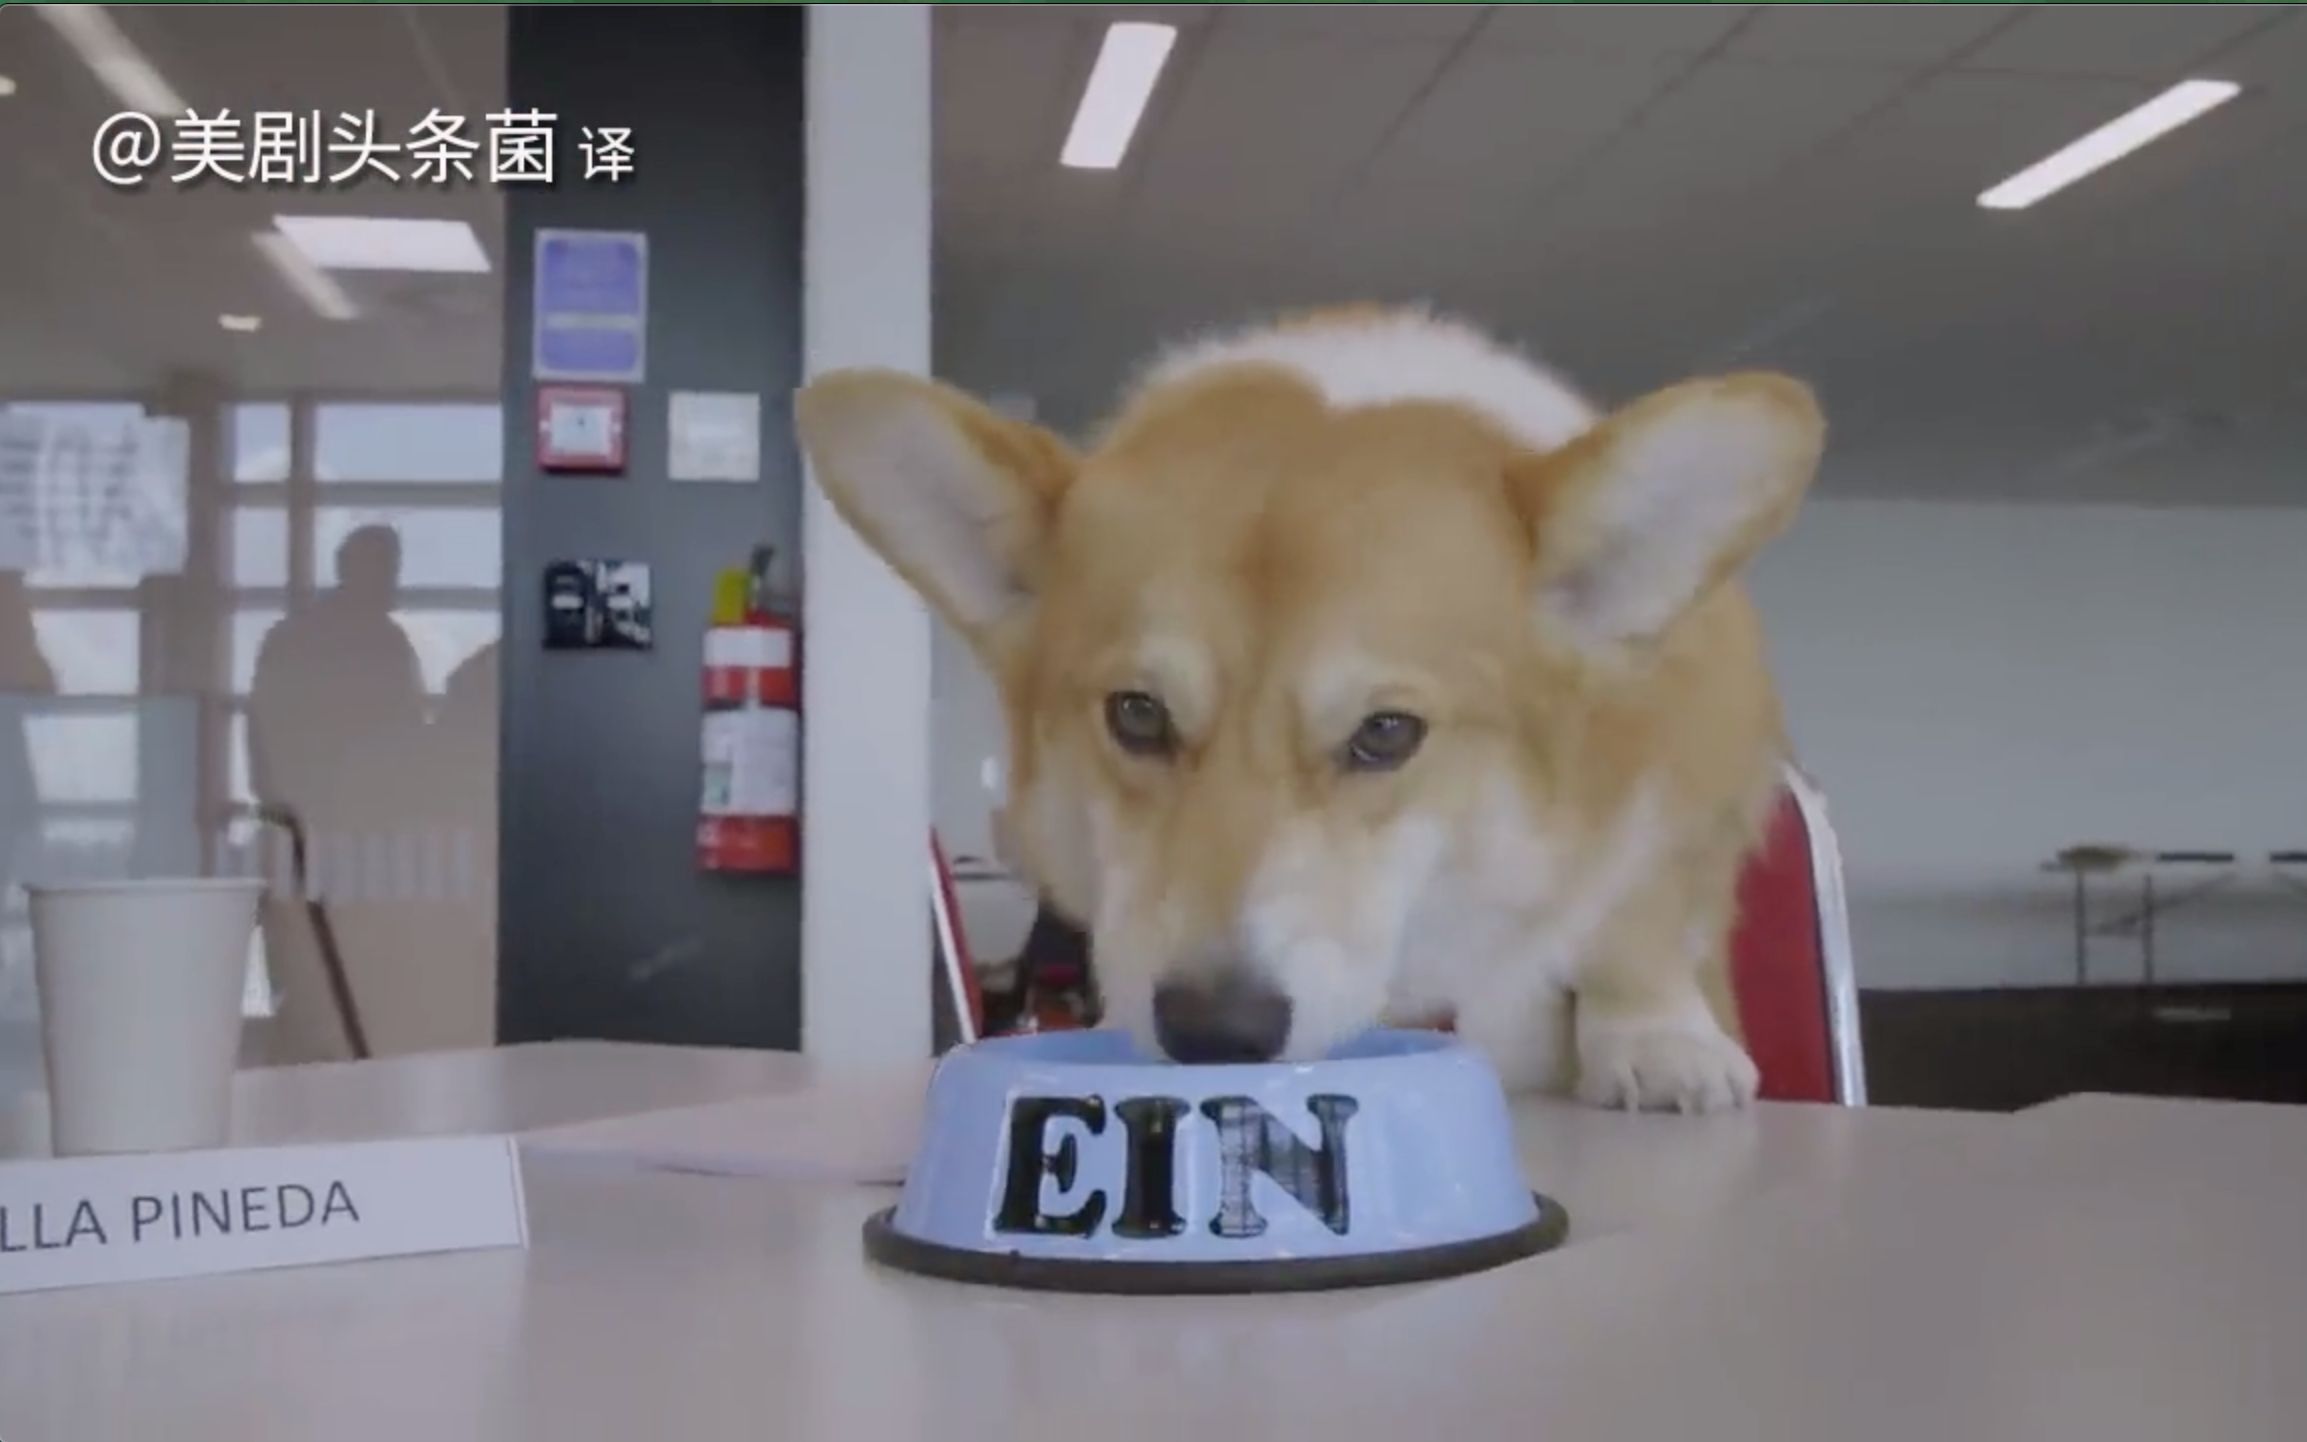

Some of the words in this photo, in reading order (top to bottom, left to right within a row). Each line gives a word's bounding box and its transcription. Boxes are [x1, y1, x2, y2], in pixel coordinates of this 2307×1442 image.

[0, 1199, 108, 1253] LLA
[131, 1180, 361, 1242] PINEDA
[994, 1092, 1358, 1239] EIN
